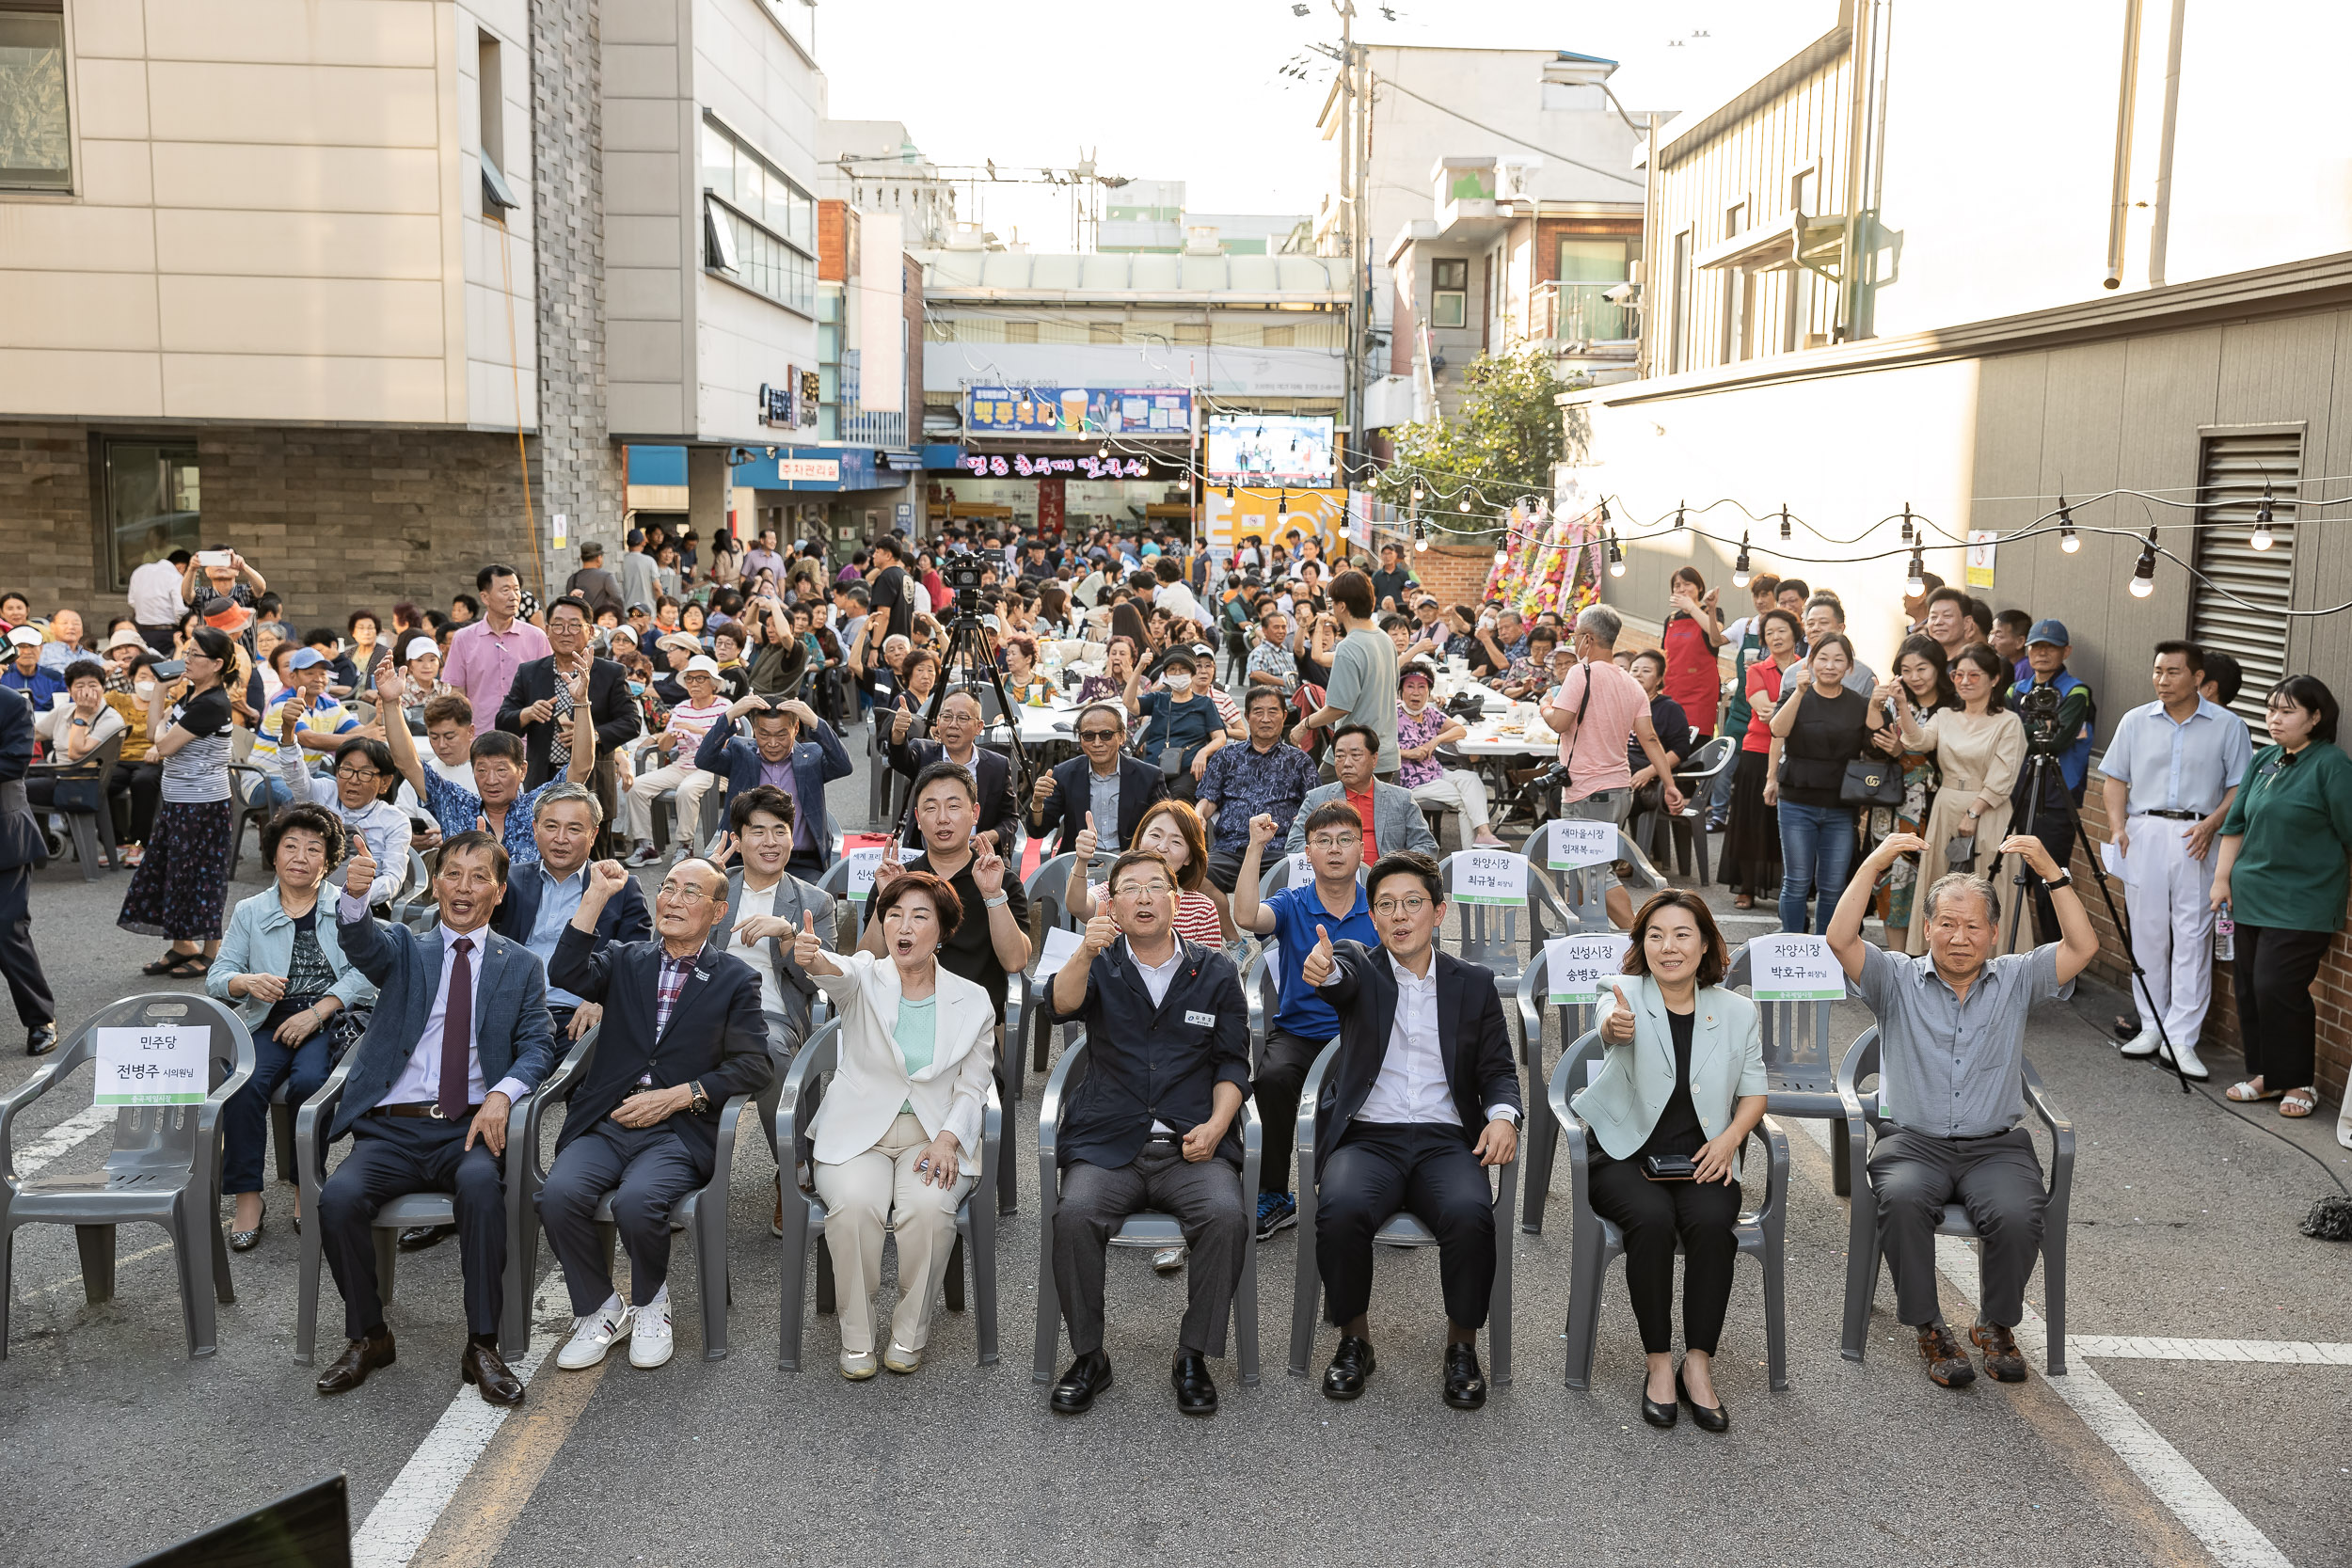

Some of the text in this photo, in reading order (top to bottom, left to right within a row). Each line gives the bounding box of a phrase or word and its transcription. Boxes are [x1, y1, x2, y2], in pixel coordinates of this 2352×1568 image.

[782, 464, 837, 477] 주차관리실
[966, 455, 1009, 476] 명동
[1562, 828, 1604, 840] 새마을시장
[1562, 844, 1588, 855] 임재복
[1471, 857, 1511, 870] 화양시장
[1468, 875, 1496, 887] 최규철
[1569, 945, 1613, 959] 신성시장
[1774, 943, 1821, 958] 자양시장
[1565, 968, 1600, 982] 송병호
[1771, 966, 1827, 978] 박호규 회장님
[140, 1036, 177, 1050] 민주당
[117, 1063, 194, 1080] 전병주 시의원님
